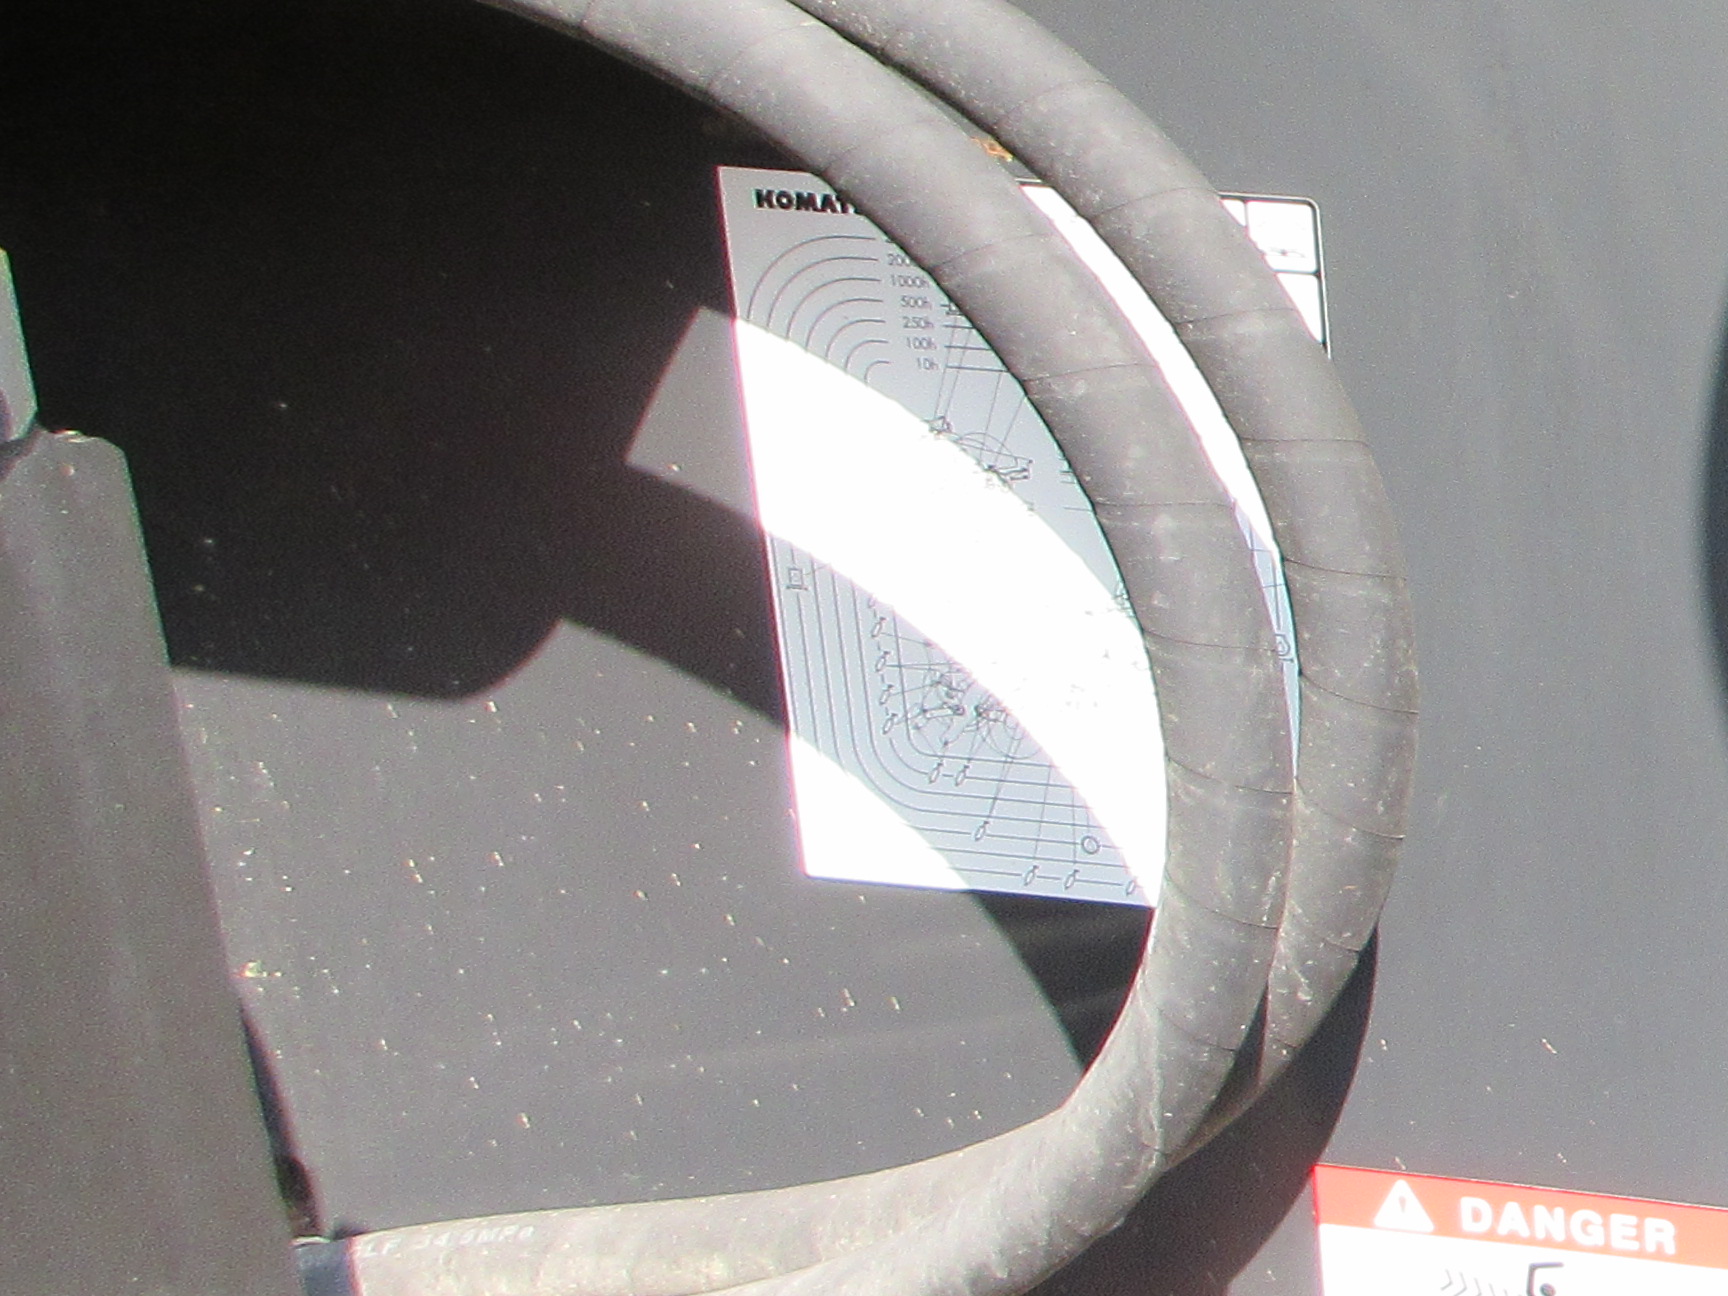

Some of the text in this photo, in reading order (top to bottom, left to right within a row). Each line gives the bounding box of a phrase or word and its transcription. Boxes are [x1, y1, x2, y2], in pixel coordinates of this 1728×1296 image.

[890, 274, 930, 289] 1000h
[901, 295, 933, 309] 500h
[903, 316, 935, 330] 250h
[906, 337, 937, 350] 100h
[917, 357, 939, 371] 10h
[1461, 1196, 1676, 1255] DANGER
